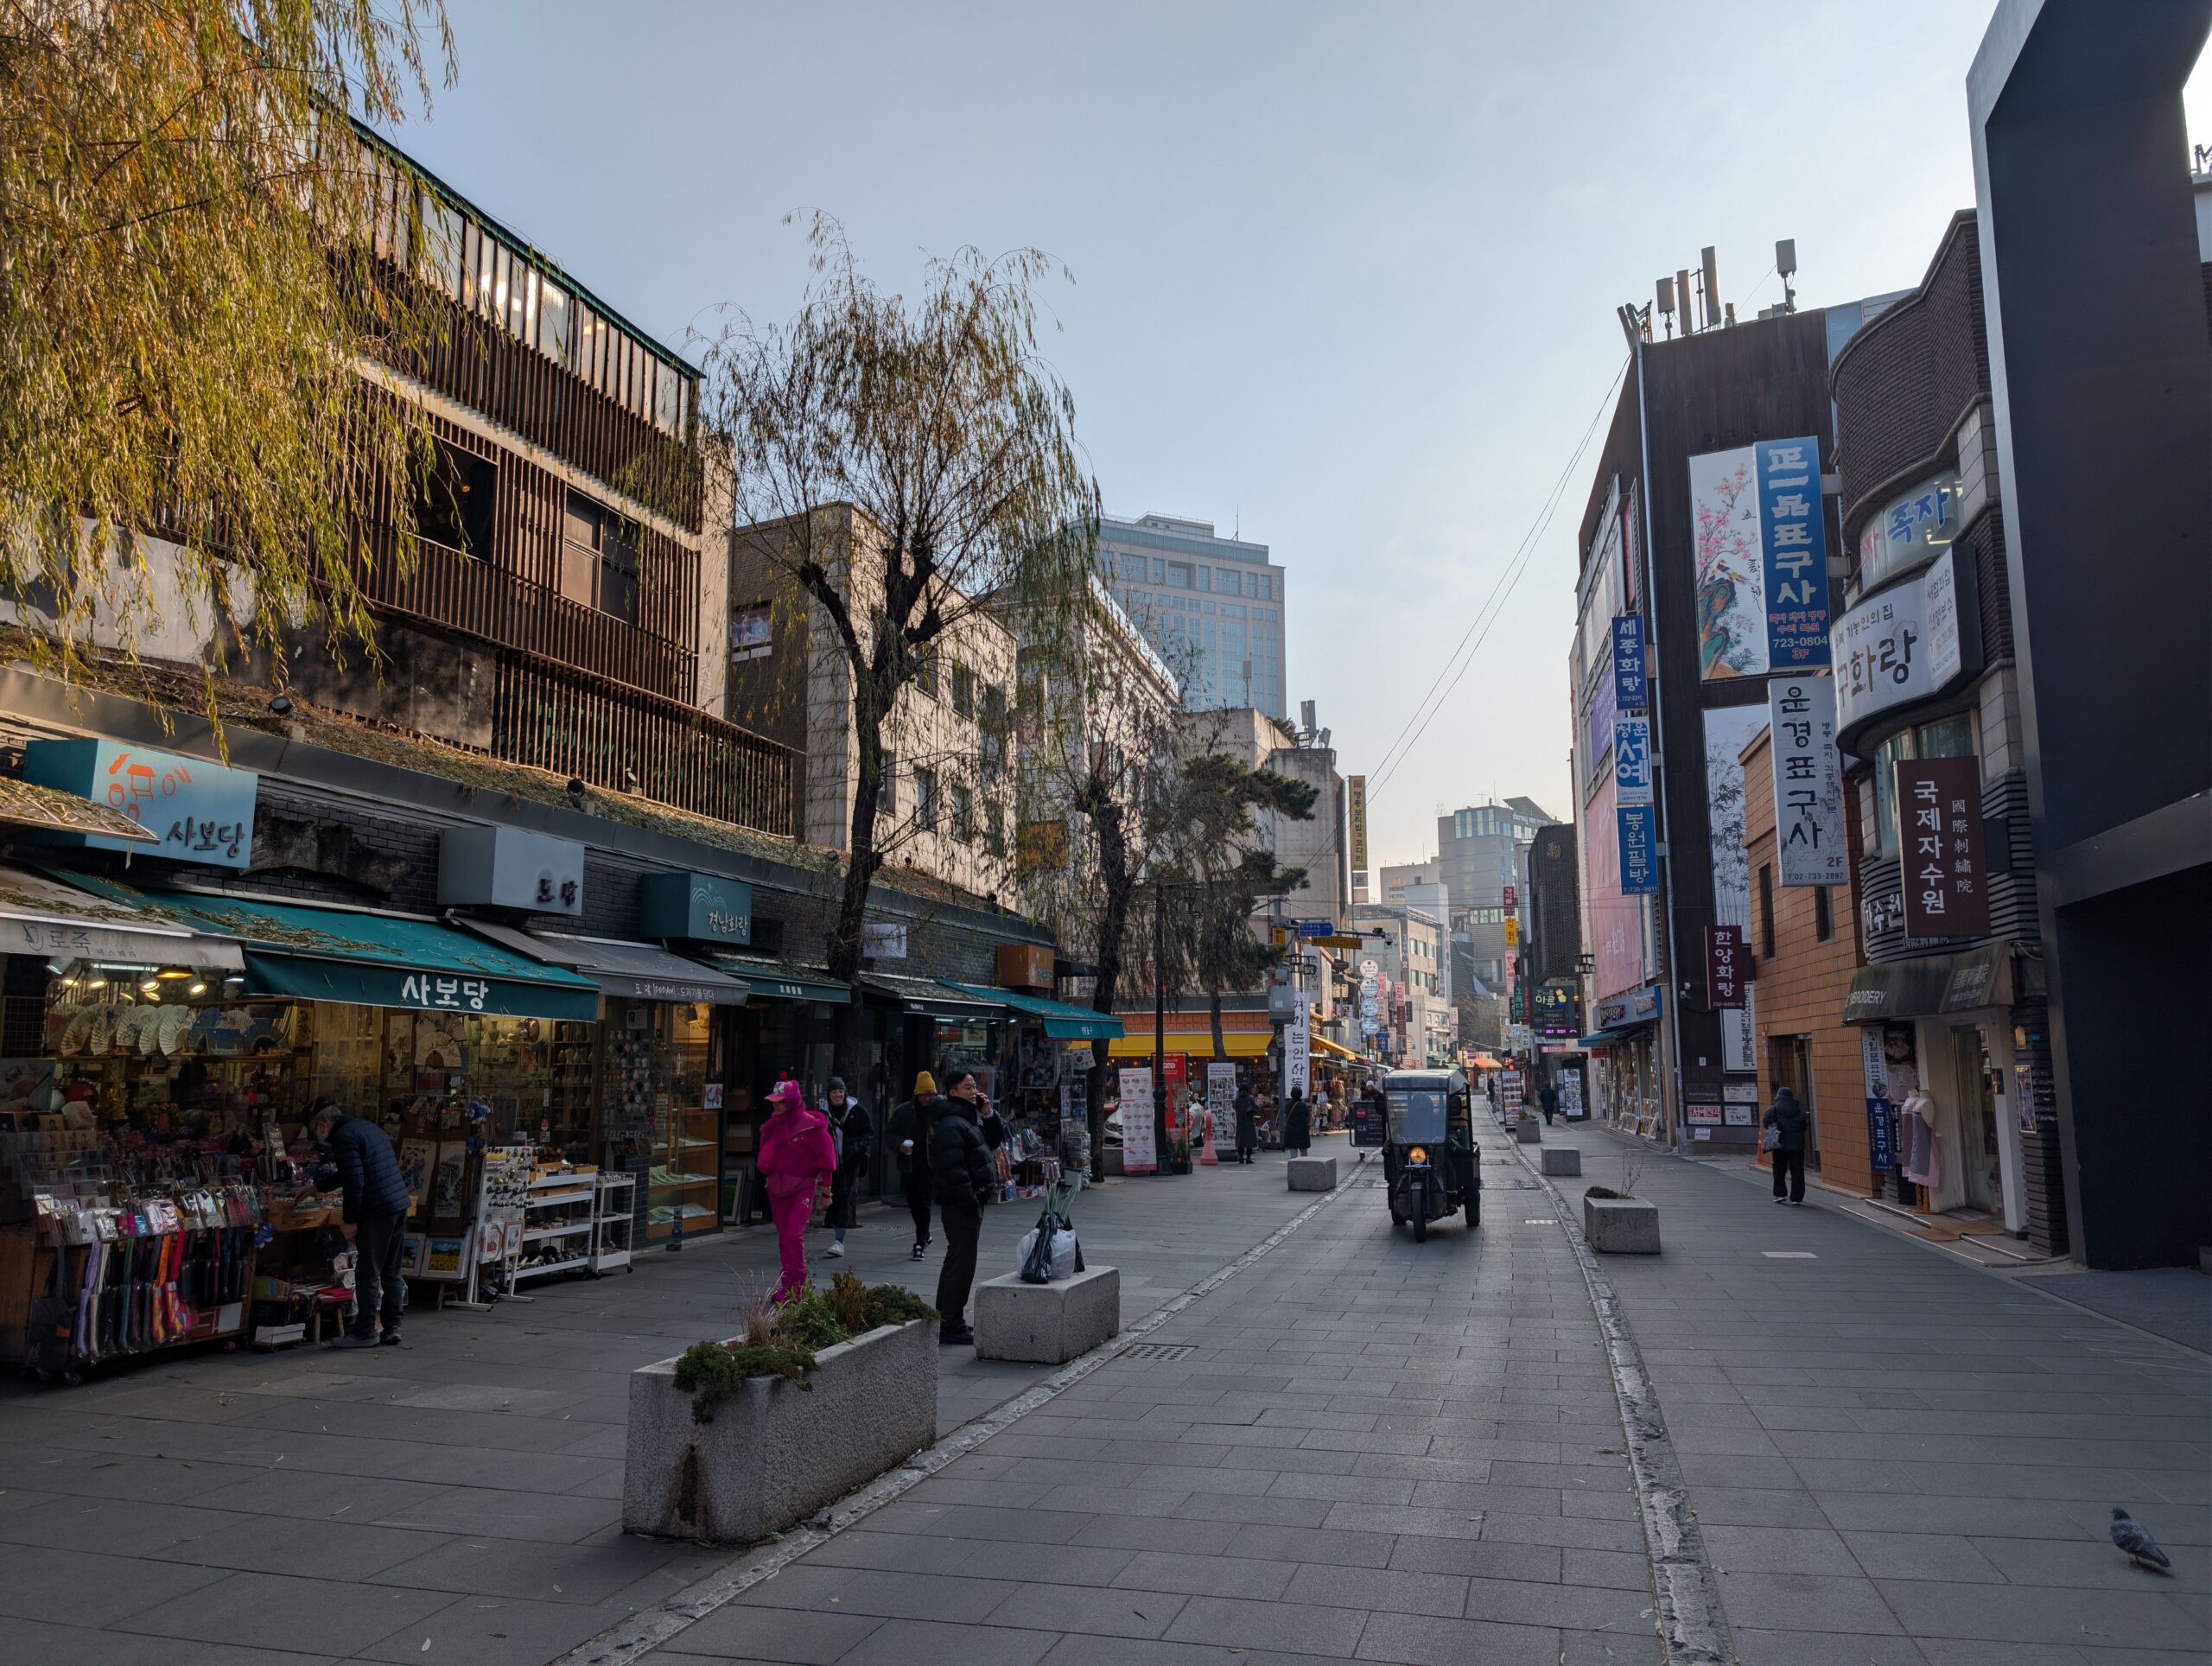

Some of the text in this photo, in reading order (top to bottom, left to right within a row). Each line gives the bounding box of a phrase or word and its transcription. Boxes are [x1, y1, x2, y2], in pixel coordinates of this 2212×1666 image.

[1887, 486, 1949, 544] 족자
[1882, 603, 1894, 620] 집
[1618, 619, 1642, 692] 세종화랑
[1772, 636, 1828, 648] 723-0804
[1791, 647, 1809, 659] 3F
[1616, 737, 1651, 785] 서예
[1778, 686, 1823, 849] 운경표구사
[168, 816, 246, 858] 사보당
[1913, 780, 1946, 914] 국제자수원
[1787, 872, 1844, 881] T.02-733-2897
[1827, 856, 1844, 868] 2F
[708, 910, 748, 936] 경남화랑
[1714, 931, 1735, 997] 한양화랑
[401, 973, 490, 1010] 사보당
[1535, 995, 1556, 1008] 마루
[1874, 1103, 1888, 1164] 운경표구사
